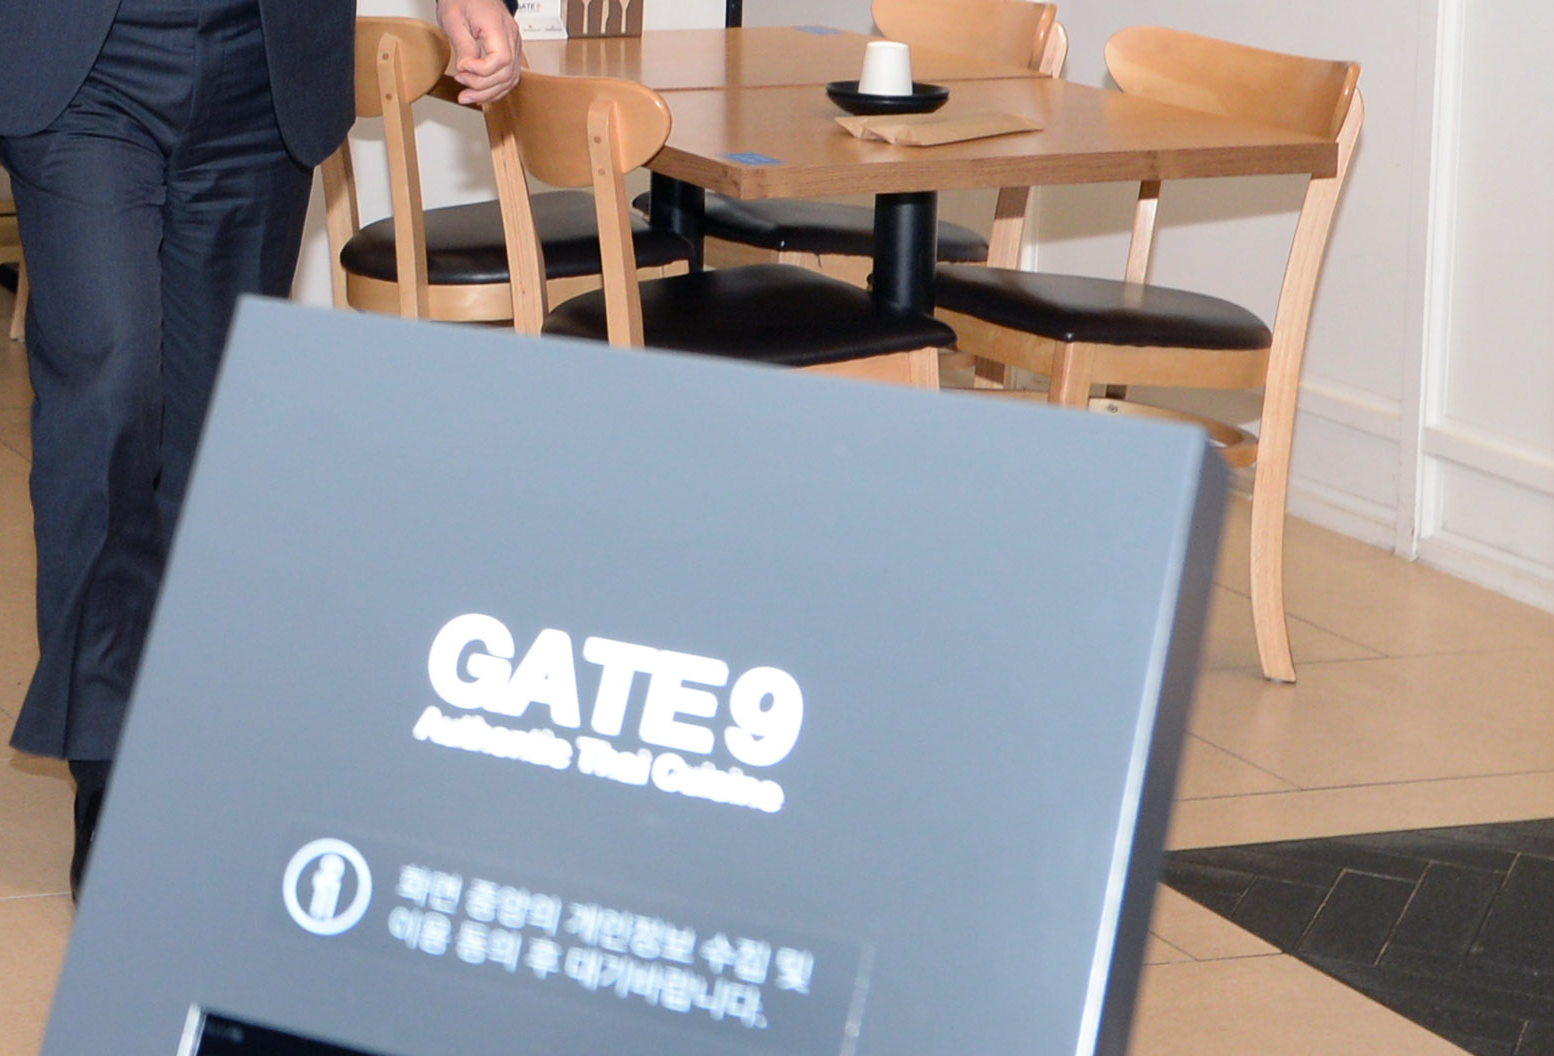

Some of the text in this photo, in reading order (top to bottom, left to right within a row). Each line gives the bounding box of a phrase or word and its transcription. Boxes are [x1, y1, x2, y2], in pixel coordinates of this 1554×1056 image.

[428, 613, 803, 766] GATE9
[387, 907, 452, 955] 이용
[456, 920, 522, 972] 동의
[775, 947, 815, 994] 및
